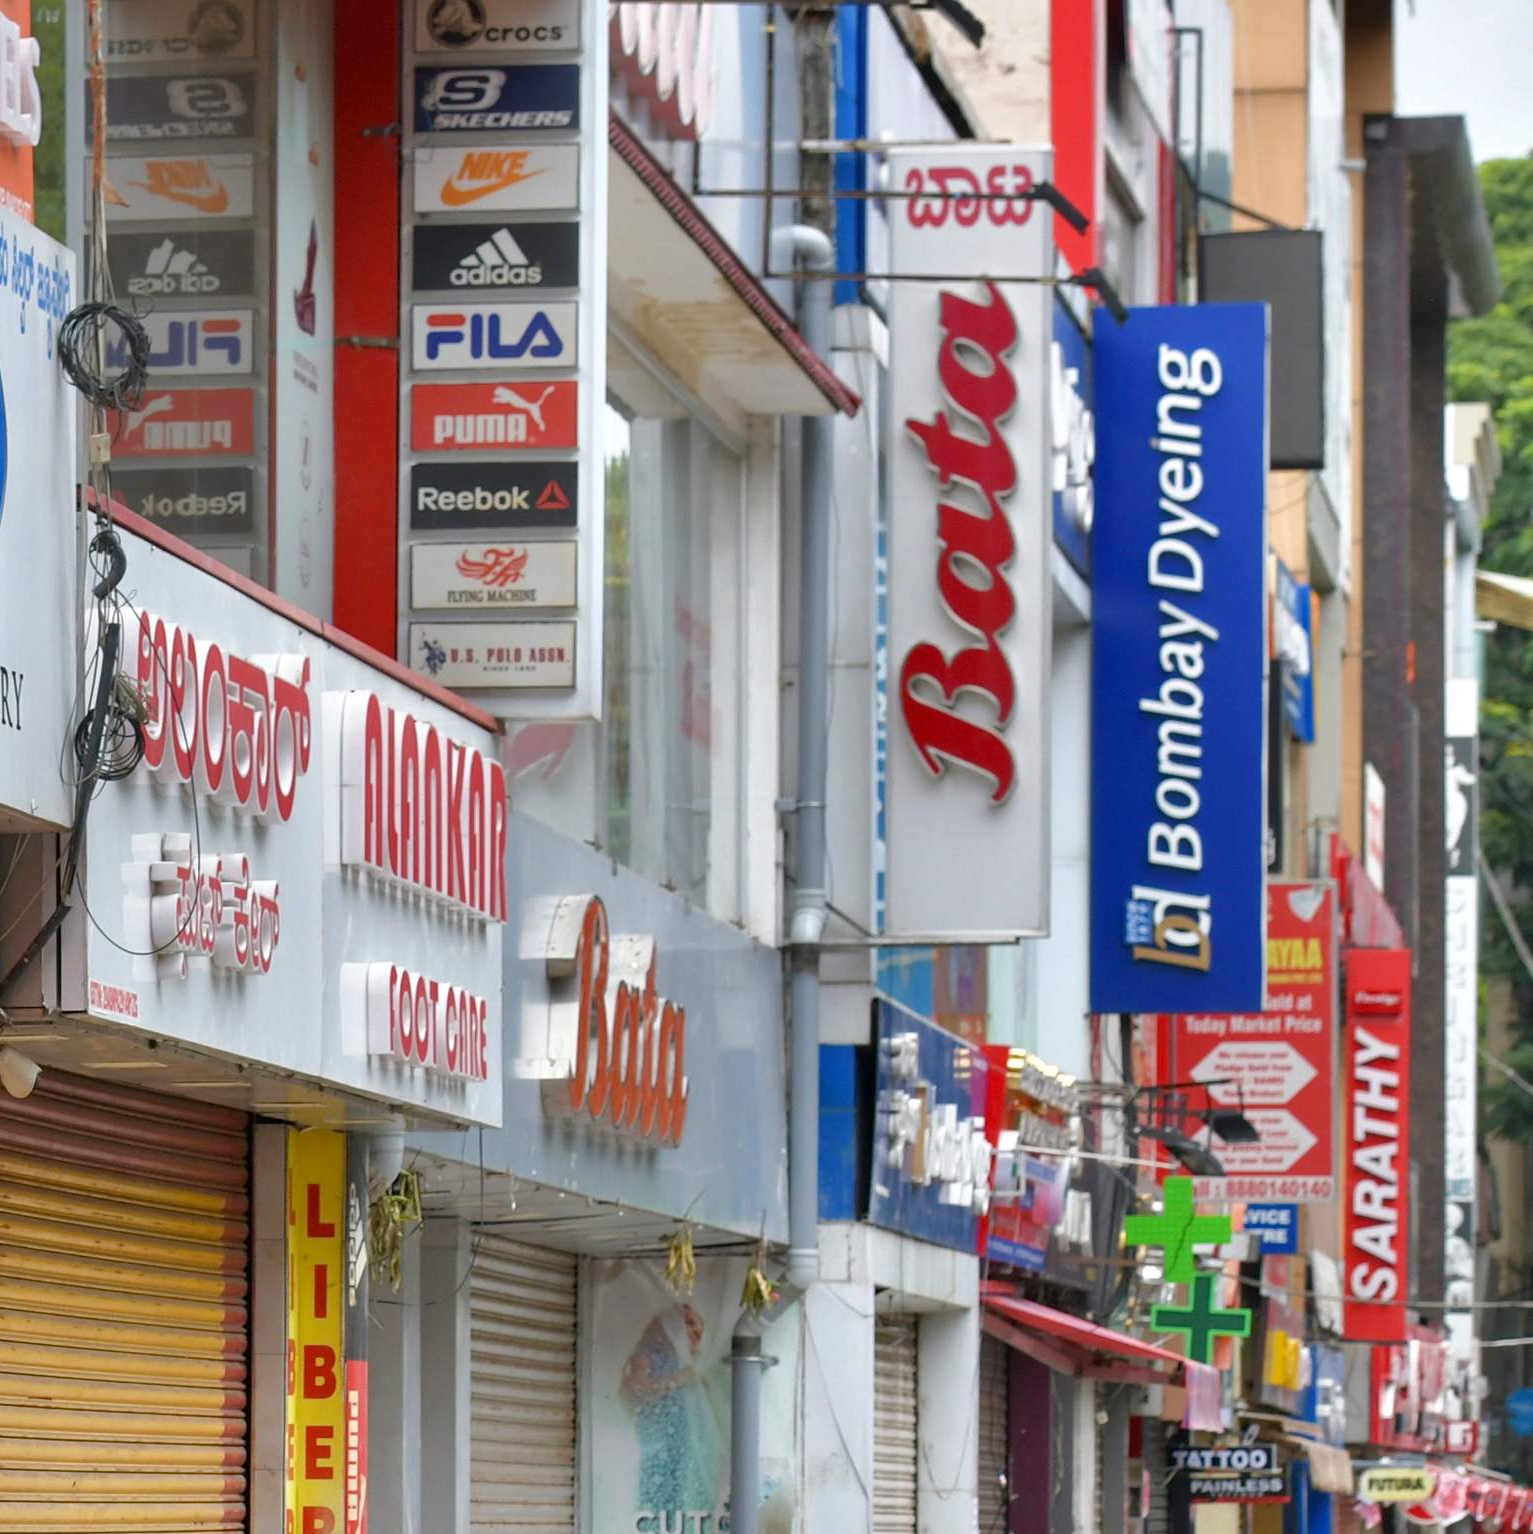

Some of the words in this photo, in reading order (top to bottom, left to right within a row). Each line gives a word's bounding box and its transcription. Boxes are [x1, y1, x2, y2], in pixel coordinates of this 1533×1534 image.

[485, 26, 563, 42] crocs
[433, 110, 573, 129] SKECHERS
[457, 151, 531, 181] NIKE
[450, 258, 542, 285] adidas
[425, 311, 563, 360] FILA
[434, 415, 527, 444] PUMA
[1148, 343, 1223, 592] Dyeing
[418, 488, 530, 512] Reebok
[900, 278, 1020, 805] Bata
[448, 590, 483, 603] FLYING
[487, 589, 537, 602] MACHINE
[450, 648, 480, 664] U.S.
[487, 648, 522, 664] POLO
[529, 648, 570, 664] ASSN.
[1139, 601, 1220, 871] Bombay
[364, 692, 507, 924] ALANKAR
[389, 965, 439, 1068] FOOT
[444, 983, 488, 1081] CARE
[569, 896, 689, 1149] Bata
[1186, 1016, 1226, 1037] Today
[1232, 1016, 1279, 1034] Market
[1285, 1015, 1323, 1034] Price
[1349, 1025, 1400, 1303] SARATHY
[1226, 1181, 1331, 1198] 8880140140
[347, 1389, 359, 1522] PUMA
[1172, 1449, 1268, 1469] TATTOO
[1190, 1477, 1283, 1494] PAINLESS
[1368, 1476, 1426, 1492] FUTURA
